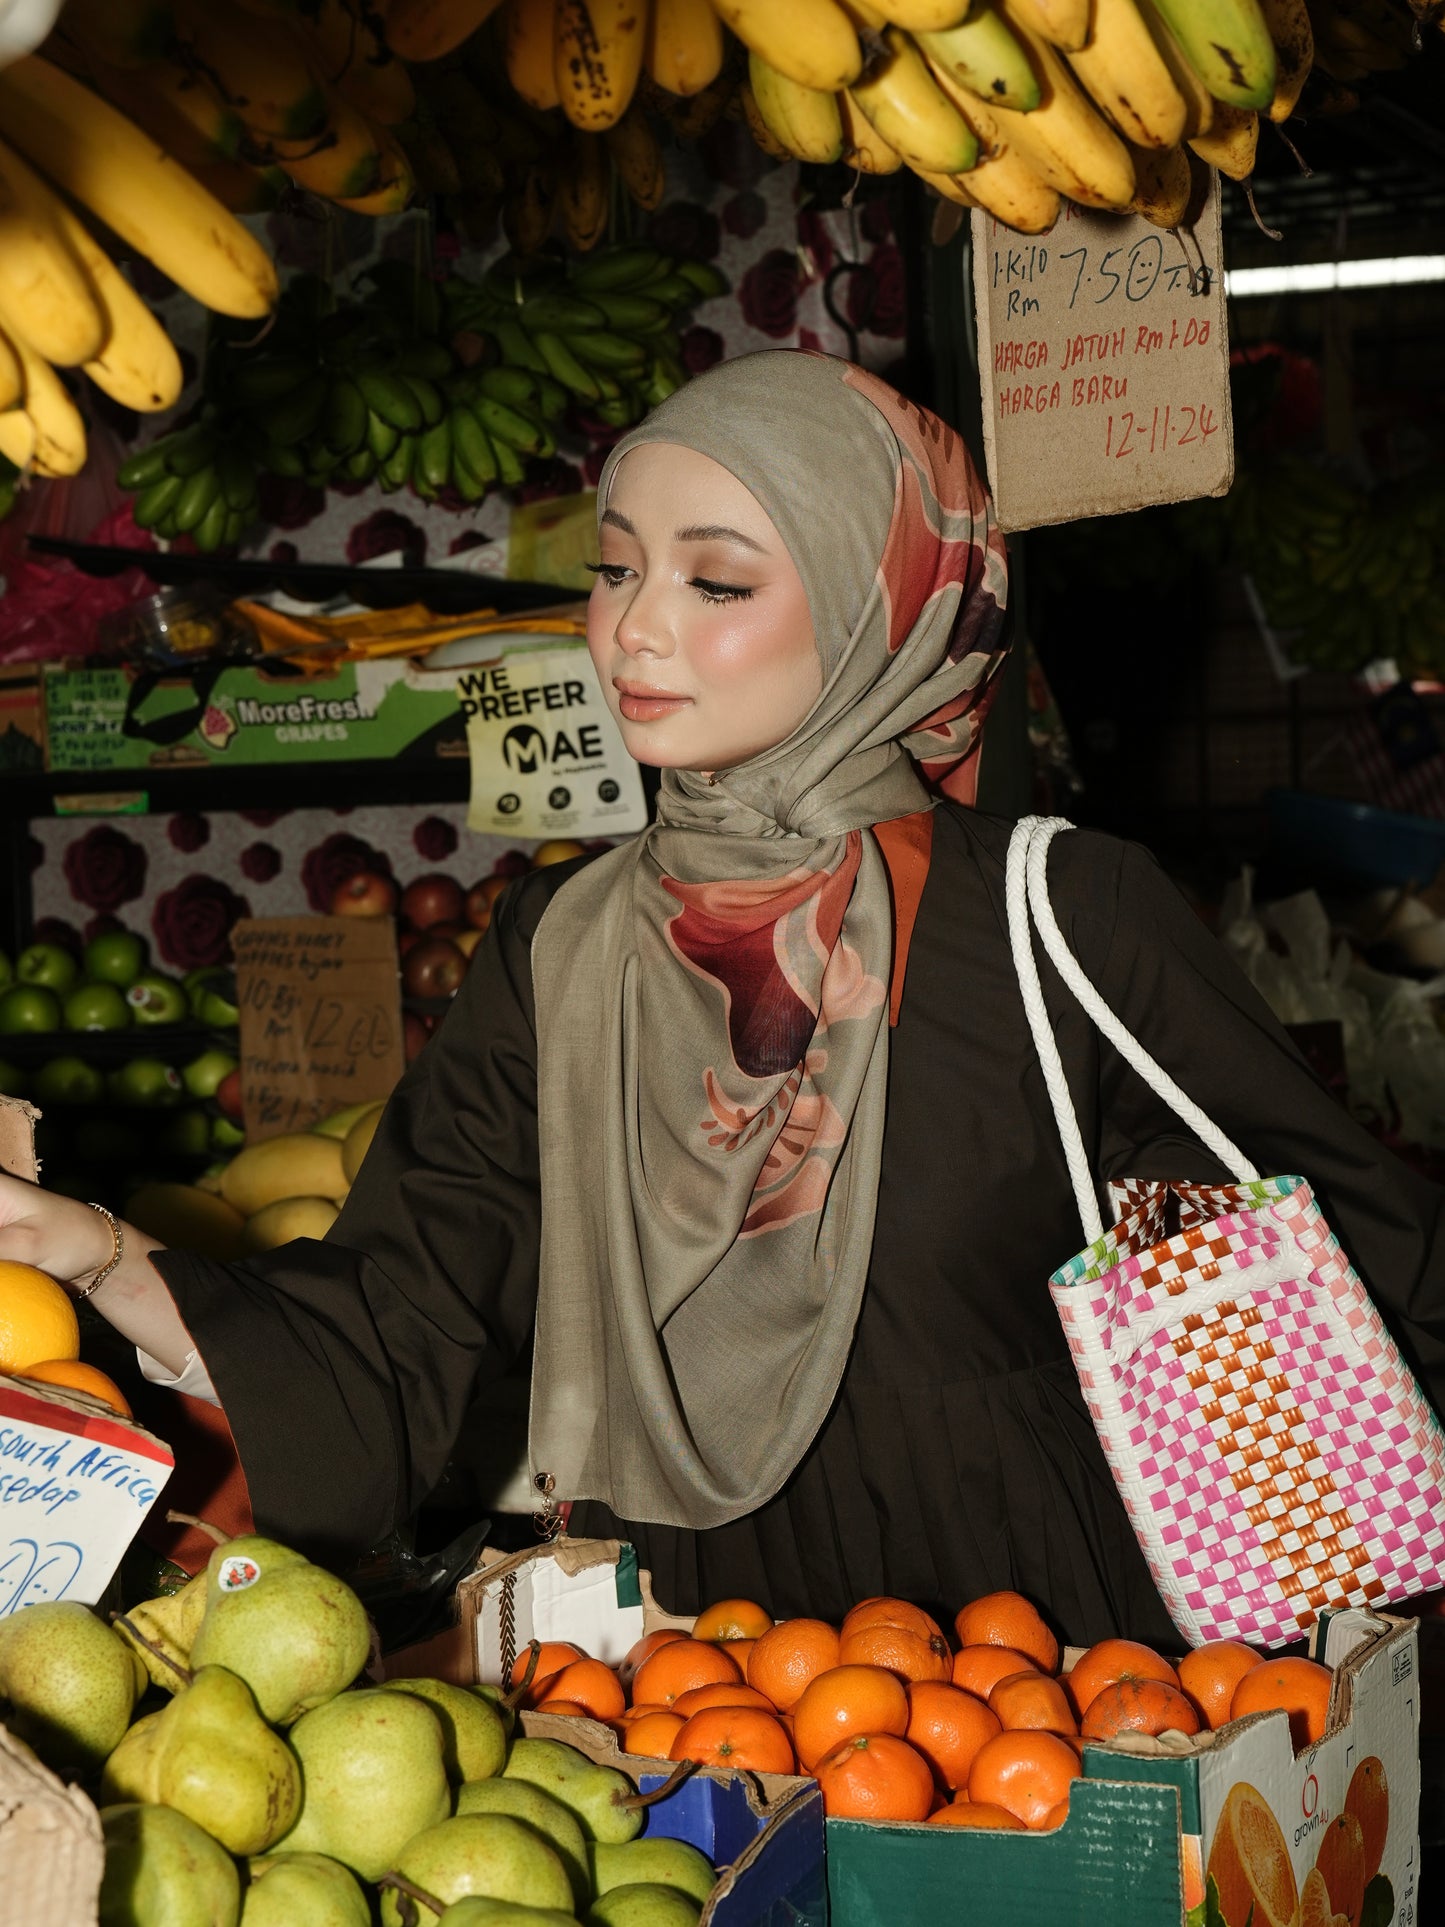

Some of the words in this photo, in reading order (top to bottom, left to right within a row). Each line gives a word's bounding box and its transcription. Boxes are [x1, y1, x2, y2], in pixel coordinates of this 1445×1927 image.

[995, 341, 1049, 375] HARGA
[1060, 327, 1126, 371] JATUH
[1000, 381, 1061, 419] HARGA
[1072, 374, 1128, 406] BARU
[458, 667, 511, 697] WE
[460, 680, 587, 725] PREFER
[274, 722, 349, 744] GRAPES
[502, 724, 604, 775] MAE
